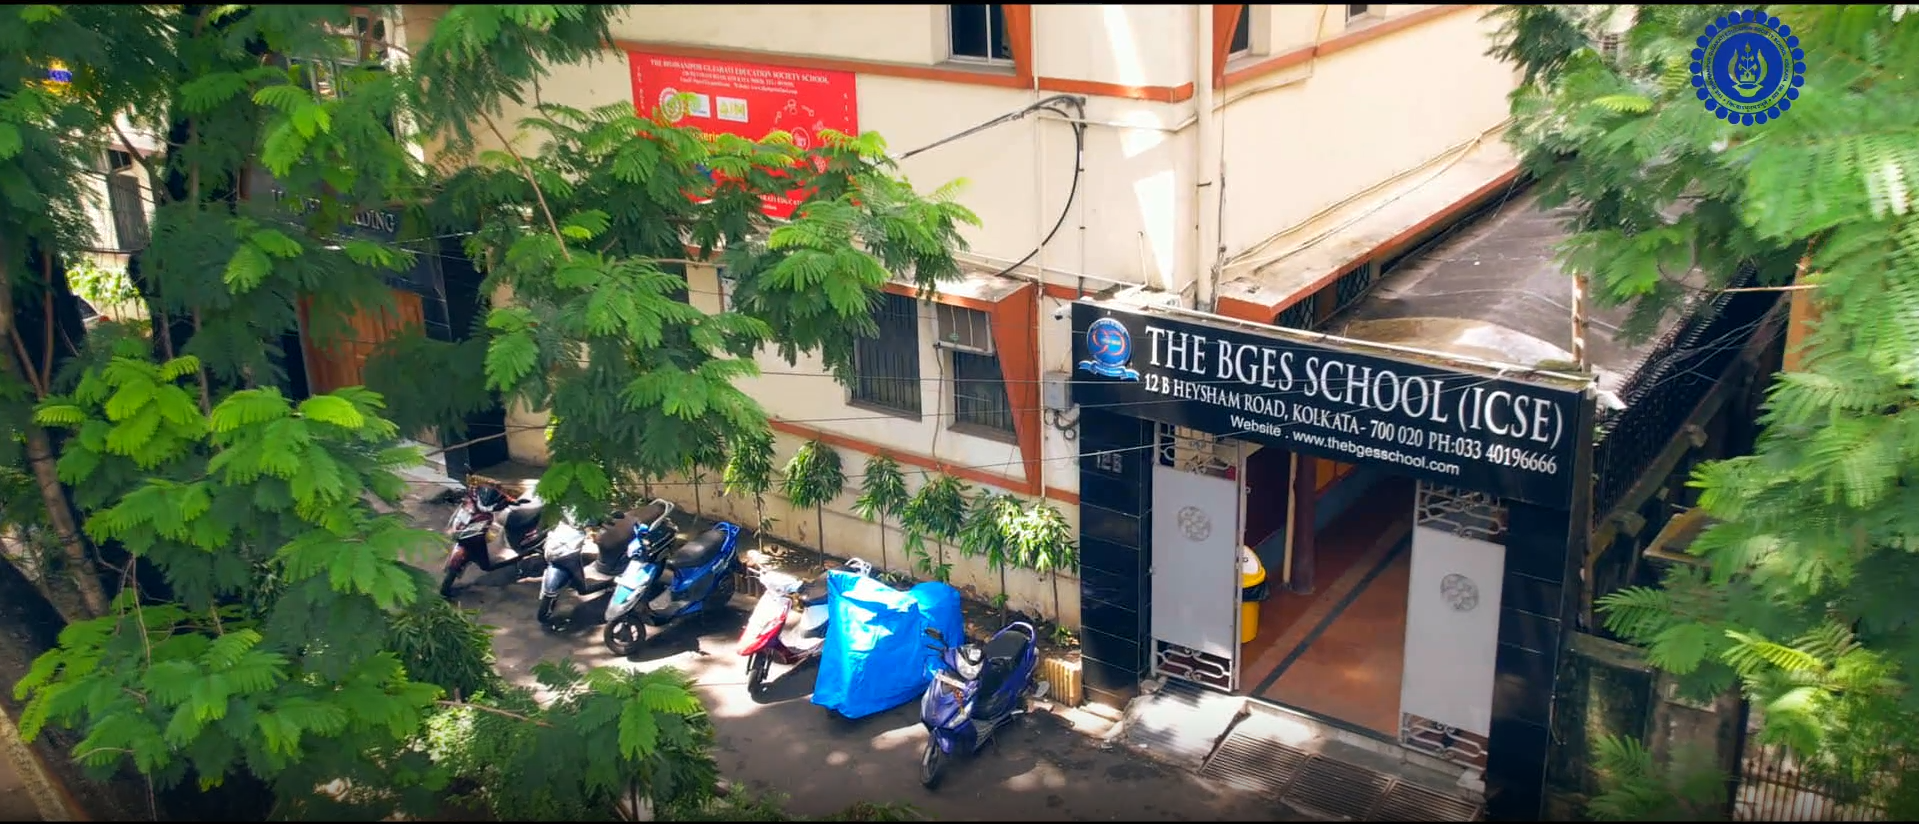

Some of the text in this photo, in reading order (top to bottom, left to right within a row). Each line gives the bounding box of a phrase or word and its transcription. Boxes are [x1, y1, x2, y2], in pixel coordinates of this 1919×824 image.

[735, 67, 772, 78] EDUCATION
[773, 71, 800, 81] SOCIETY
[801, 74, 829, 83] SCHOOL
[1144, 373, 1558, 475] 12 B HEYSHAM ROAD, KOLKATA- 700 020 PH:033 40196666
[1145, 325, 1563, 450] THE BGES SCHOOL (ICSE)
[1230, 414, 1282, 438] Website
[1292, 430, 1460, 476] www.thebgesschool.com
